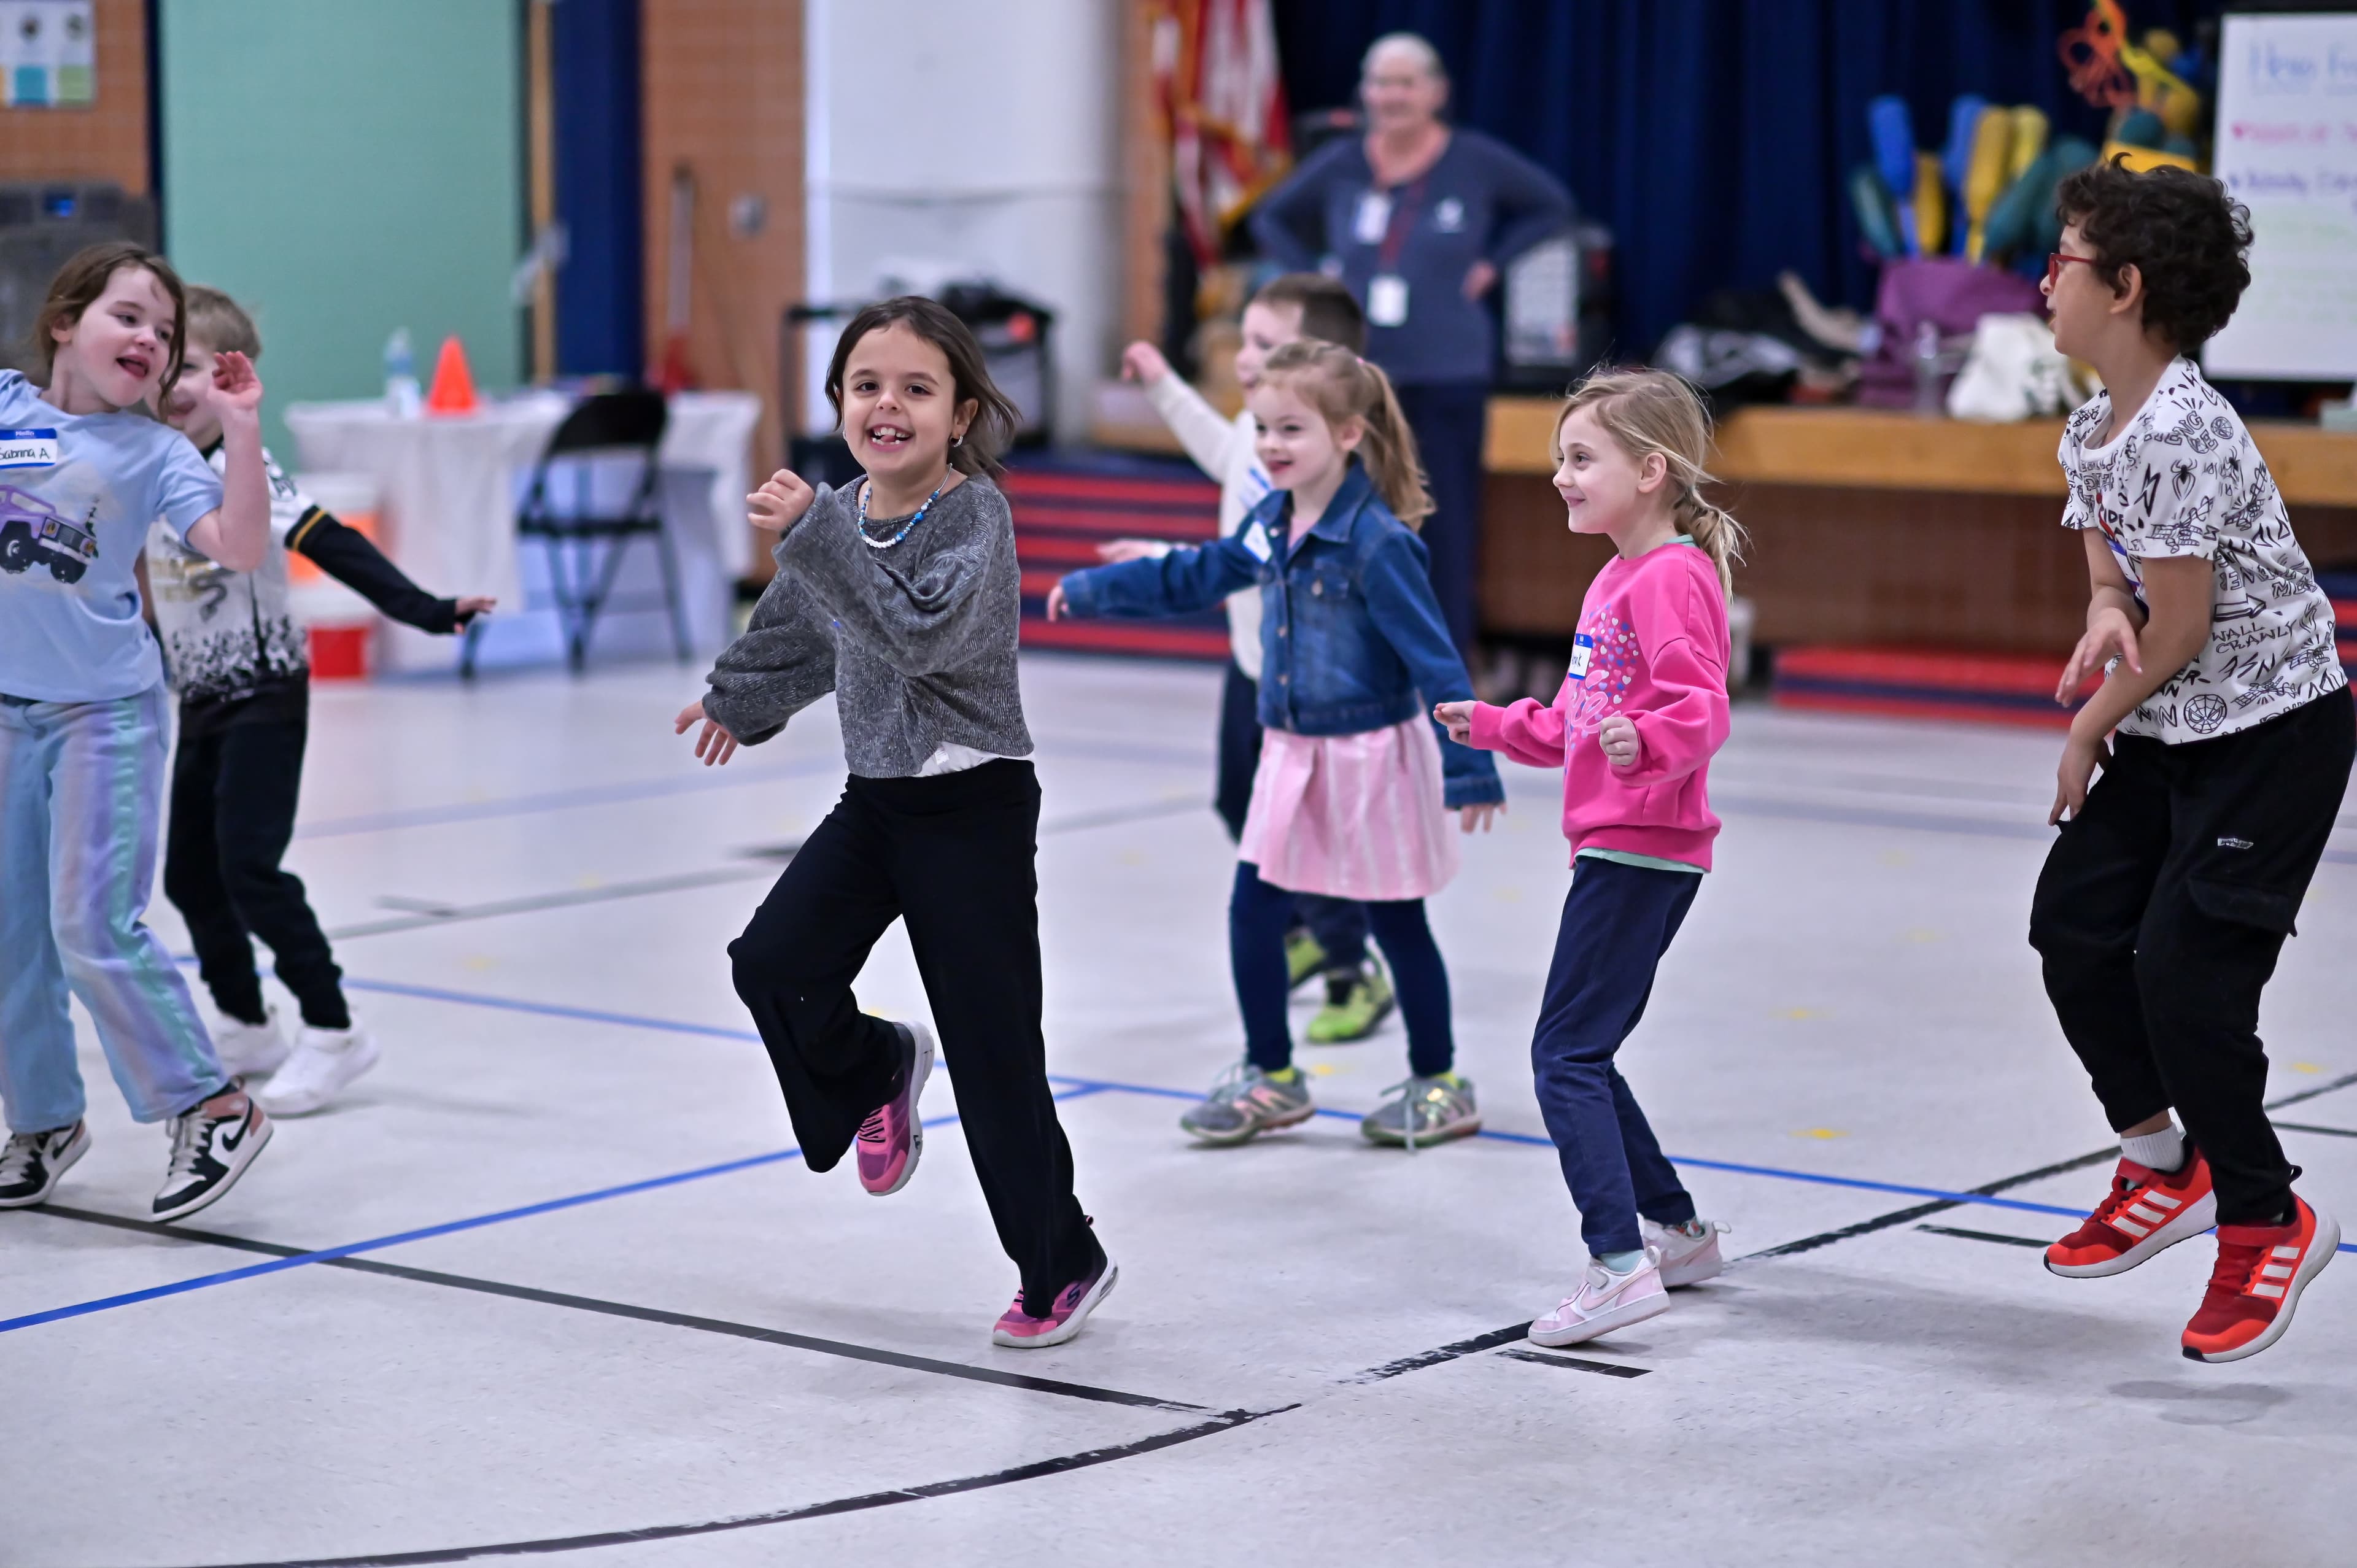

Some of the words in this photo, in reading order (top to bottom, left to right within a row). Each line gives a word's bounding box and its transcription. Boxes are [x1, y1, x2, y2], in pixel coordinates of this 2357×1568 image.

[39, 448, 50, 459] A
[2212, 621, 2265, 642] WALL
[2216, 620, 2297, 654] CRAWLY
